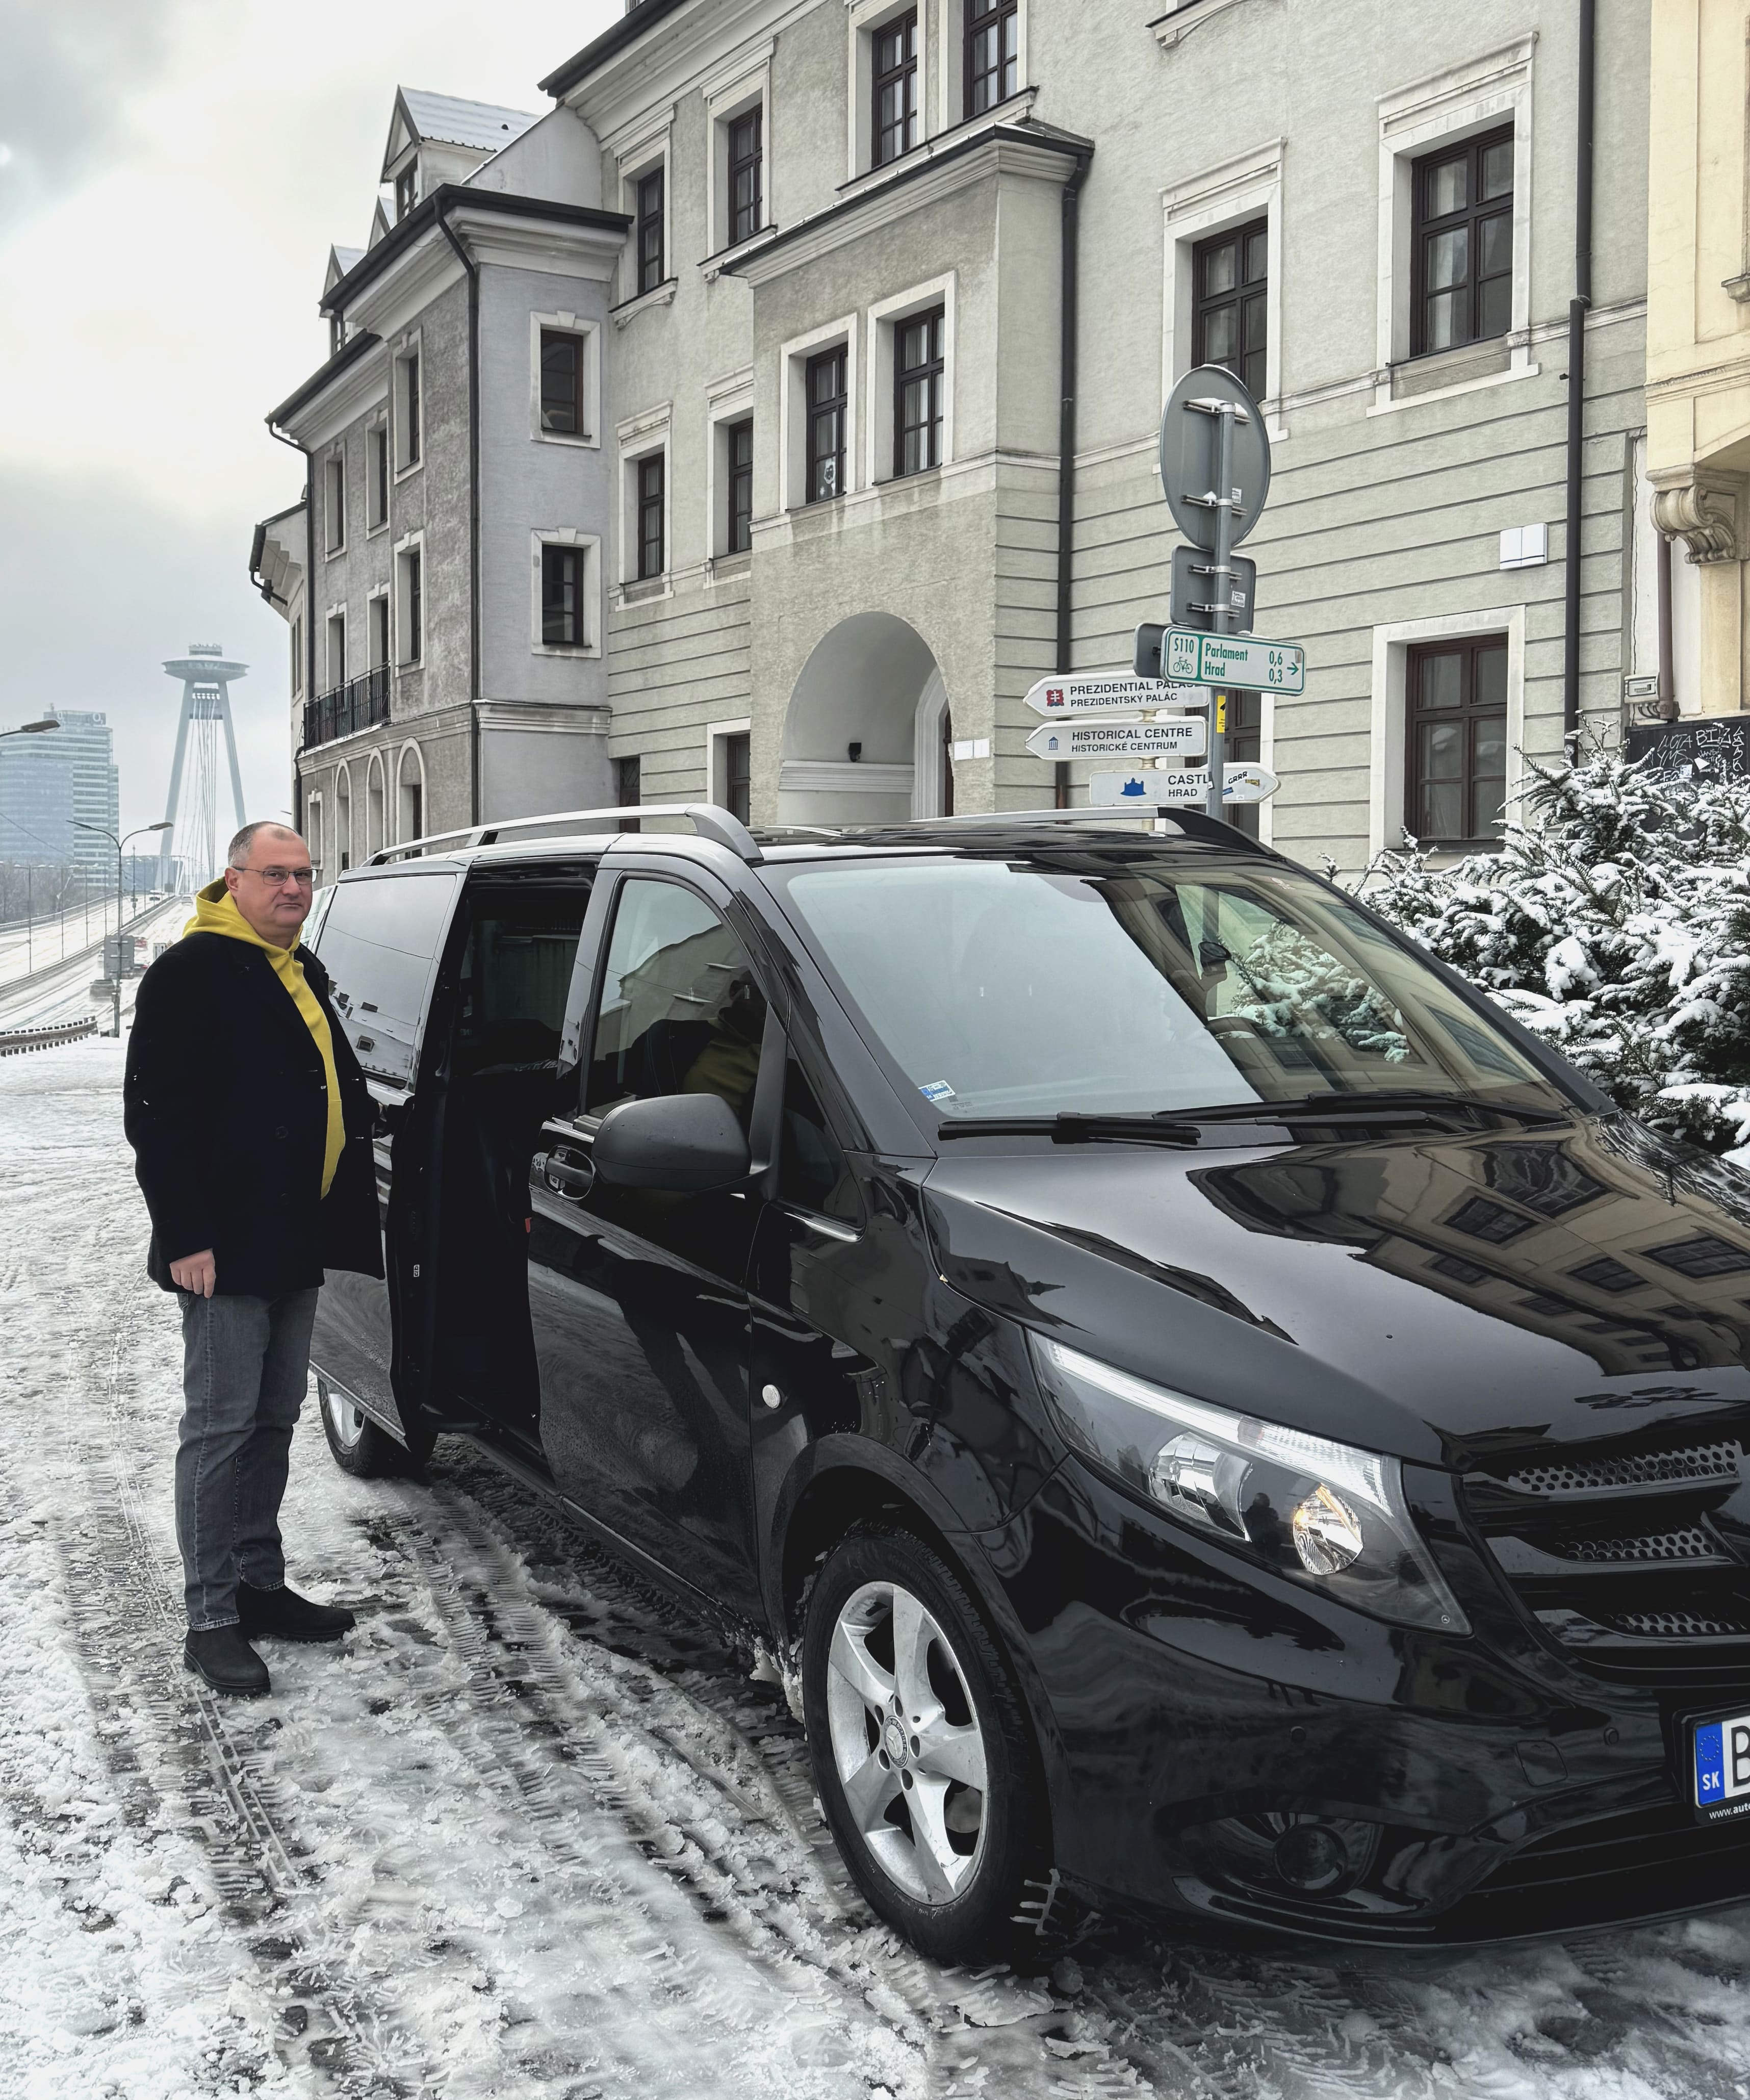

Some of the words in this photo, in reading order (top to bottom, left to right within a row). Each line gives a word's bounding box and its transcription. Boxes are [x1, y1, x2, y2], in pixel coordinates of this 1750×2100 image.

[1174, 637, 1194, 653] S110
[1205, 643, 1248, 661] Parlament
[1269, 651, 1283, 667] 0,6
[1204, 661, 1225, 677] Hrad
[1269, 668, 1283, 684] 0,3
[1070, 681, 1153, 695] PREZIDENTIAL
[1070, 693, 1143, 707] PREZIDENTSKÝ
[1146, 691, 1178, 702] PALÁC
[1072, 729, 1141, 740] HISTORICAL
[1144, 728, 1193, 738] CENTRE
[1072, 741, 1128, 752] HISTORICKÉ
[1130, 741, 1177, 750] CENTRUM
[1168, 774, 1208, 785] CASTL
[1168, 788, 1197, 797] HRAD
[1731, 1725, 1750, 1787] B
[1702, 1771, 1720, 1790] SK
